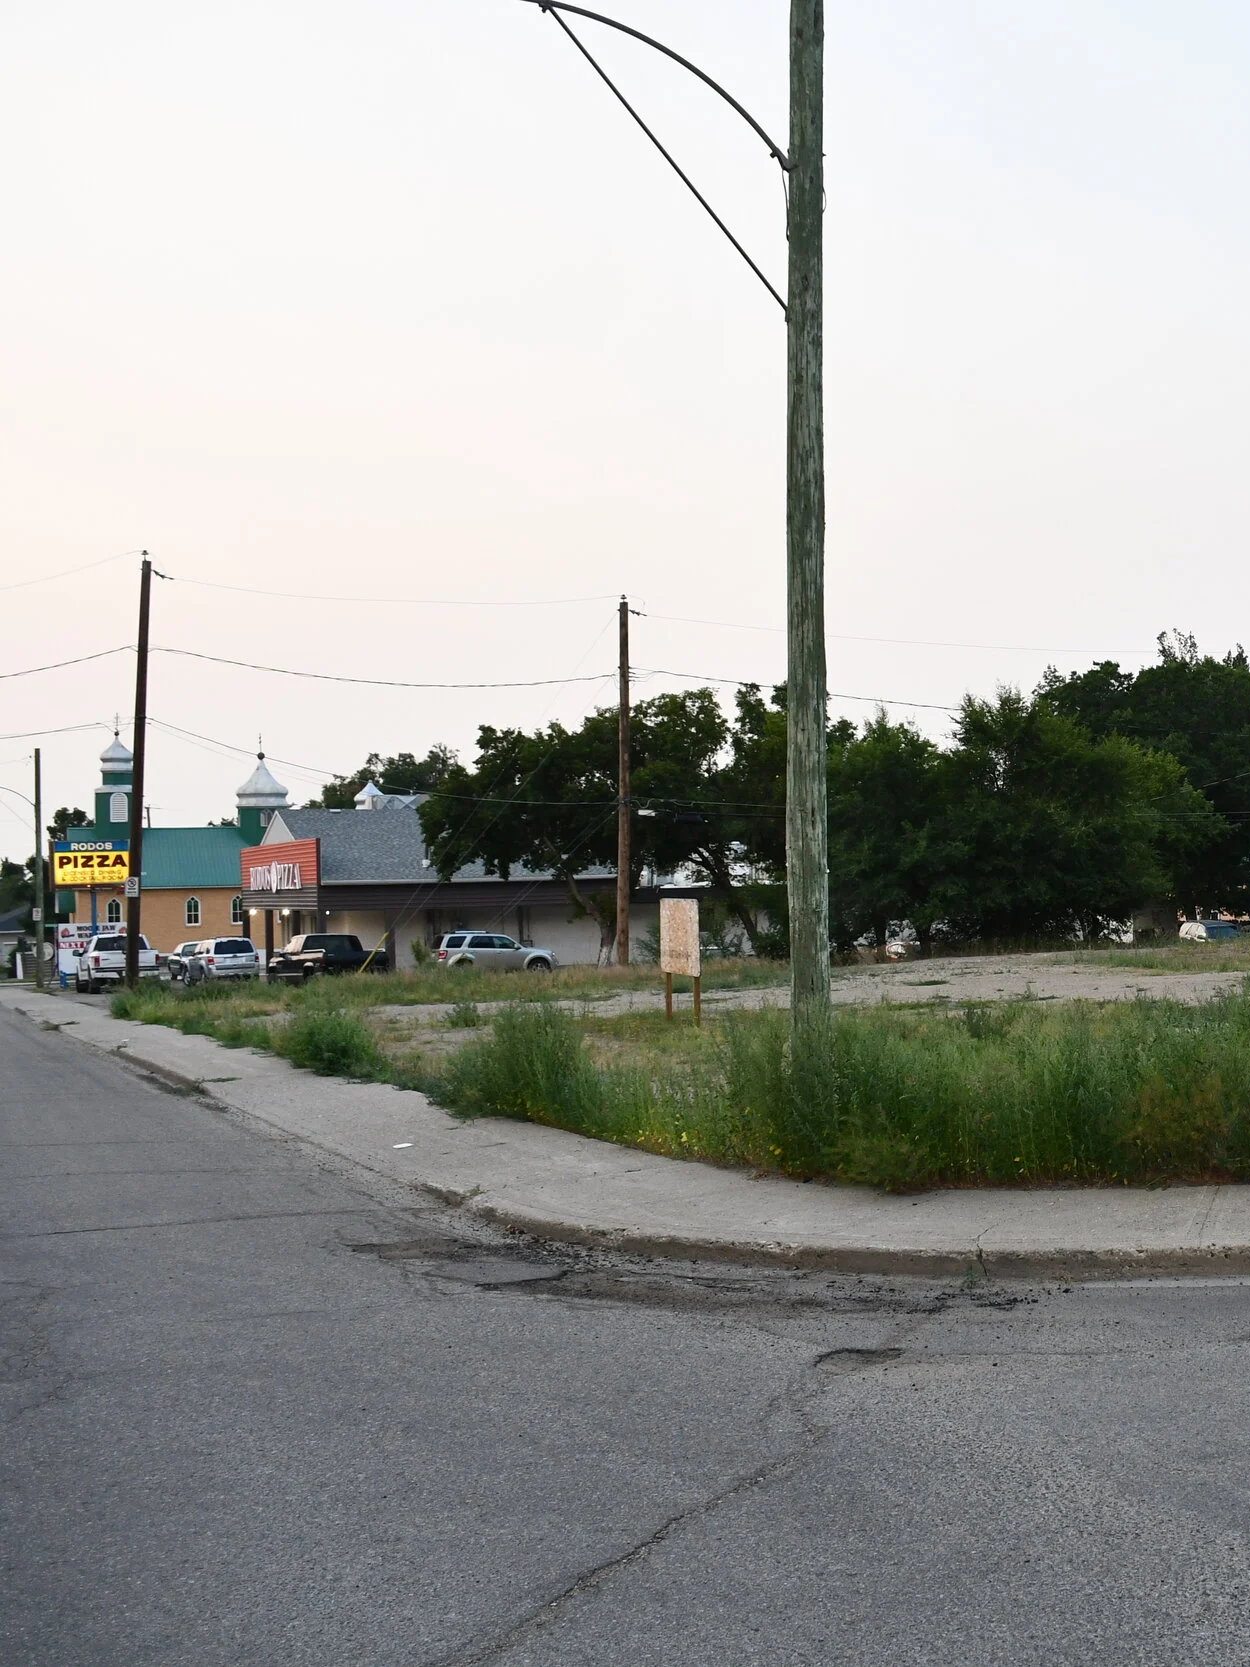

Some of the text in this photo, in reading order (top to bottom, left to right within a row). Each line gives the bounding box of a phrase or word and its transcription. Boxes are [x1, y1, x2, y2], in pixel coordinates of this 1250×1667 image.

[70, 842, 113, 851] RODOS
[58, 854, 128, 869] PIZZA
[277, 863, 302, 889] PIZZA
